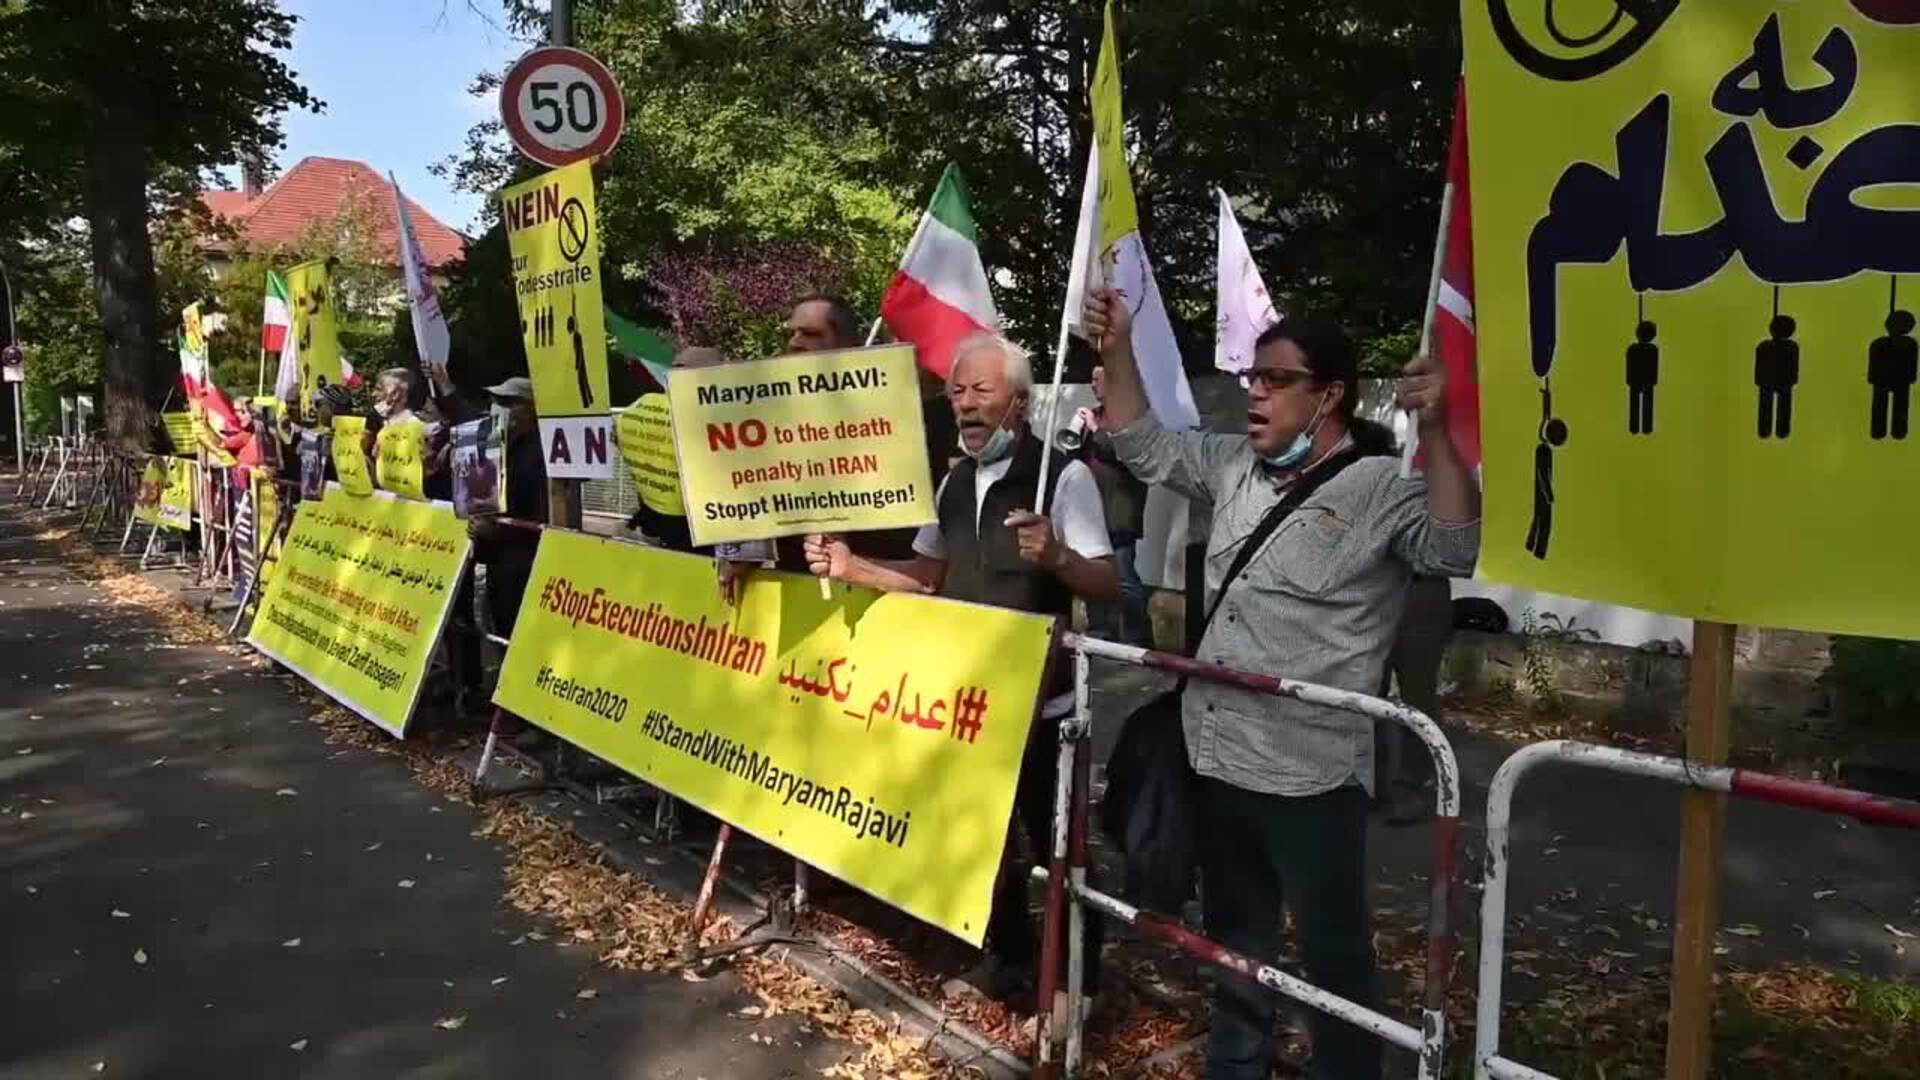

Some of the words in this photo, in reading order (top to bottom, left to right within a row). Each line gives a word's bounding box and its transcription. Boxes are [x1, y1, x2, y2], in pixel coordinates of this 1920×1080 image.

[530, 81, 598, 135] 50
[506, 182, 560, 233] NEIN
[697, 380, 791, 405] Maryam
[797, 367, 888, 394] RAJAVI:
[705, 418, 768, 452] NO
[774, 426, 794, 444] to
[798, 423, 830, 442] the
[834, 417, 893, 439] death
[731, 459, 802, 489] penalty
[806, 459, 825, 478] in
[828, 454, 879, 476] IRAN
[704, 497, 769, 520] Stoppt
[773, 483, 916, 514] Hinrichtungen!
[539, 575, 768, 677] #StopExecutionsInIran
[535, 664, 628, 724] #FreeIran2020
[640, 708, 912, 849] #IStandWithMaryamRajavi
